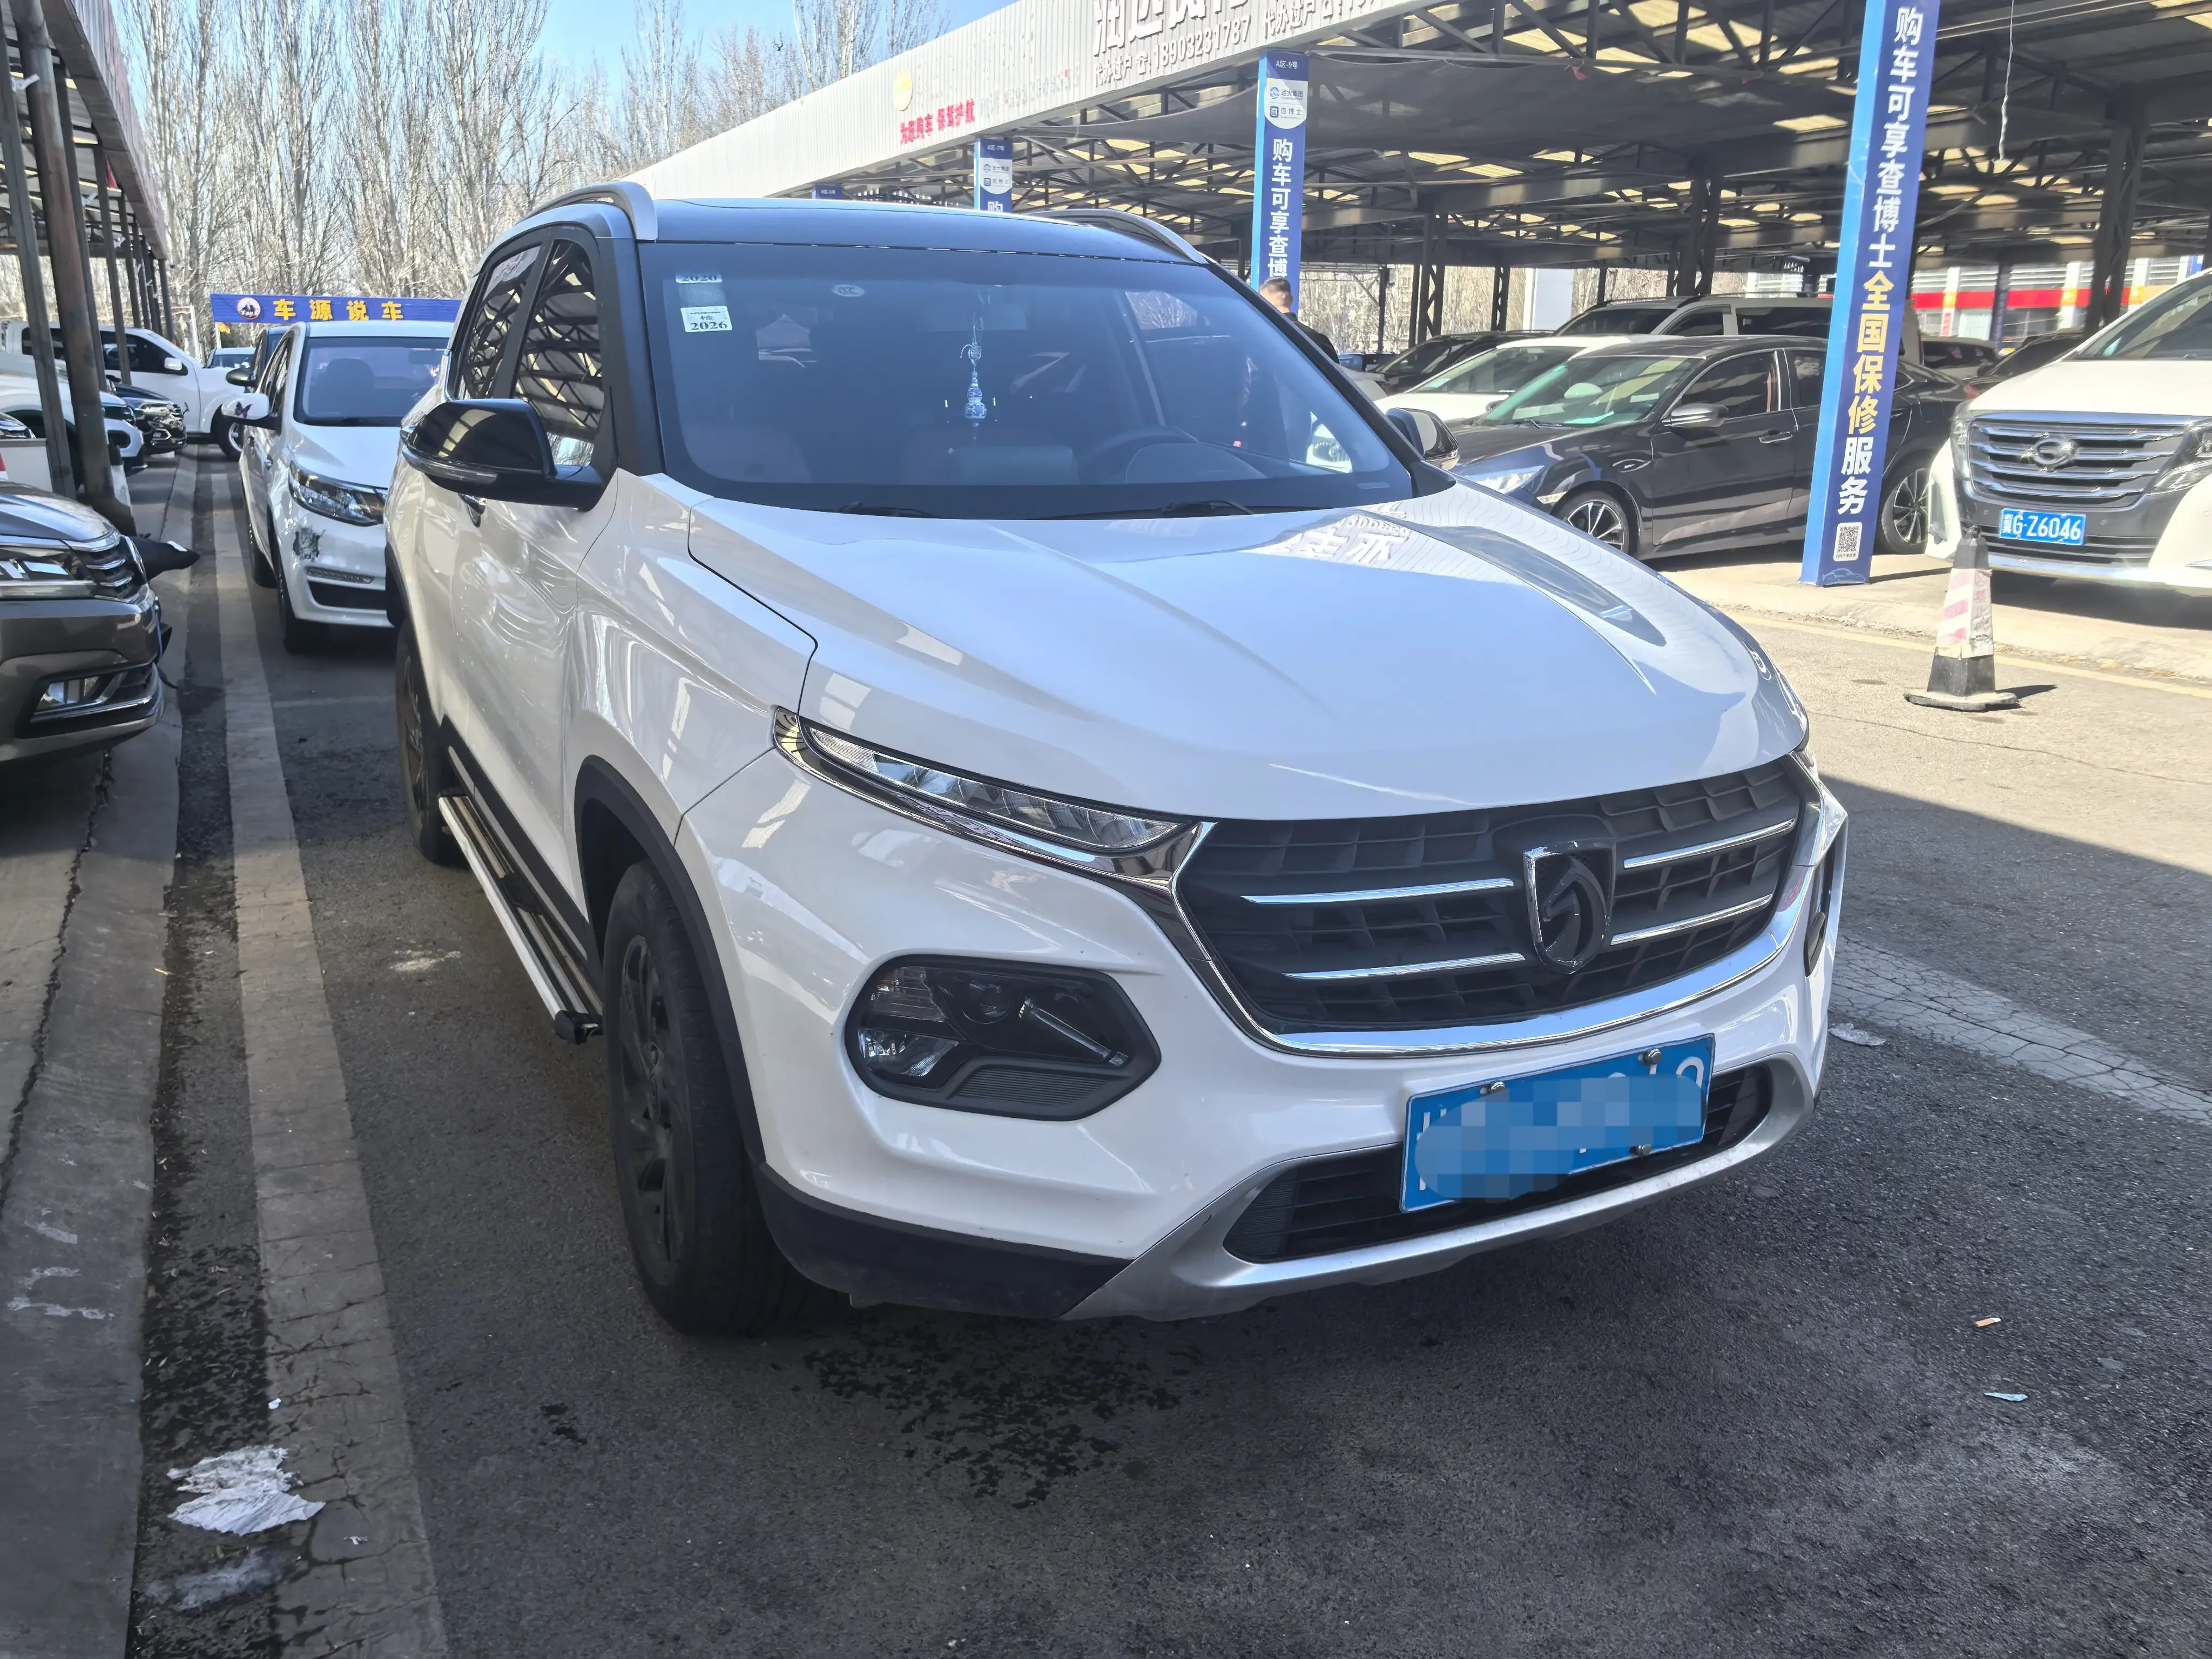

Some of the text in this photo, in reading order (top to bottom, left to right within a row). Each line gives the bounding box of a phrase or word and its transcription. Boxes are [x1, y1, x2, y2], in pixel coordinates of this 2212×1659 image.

[1276, 60, 1298, 69] A区-9号
[1837, 6, 1924, 515] 购车可享查博士全国保修服务
[273, 299, 403, 321] 车源说车
[690, 321, 727, 331] 2026
